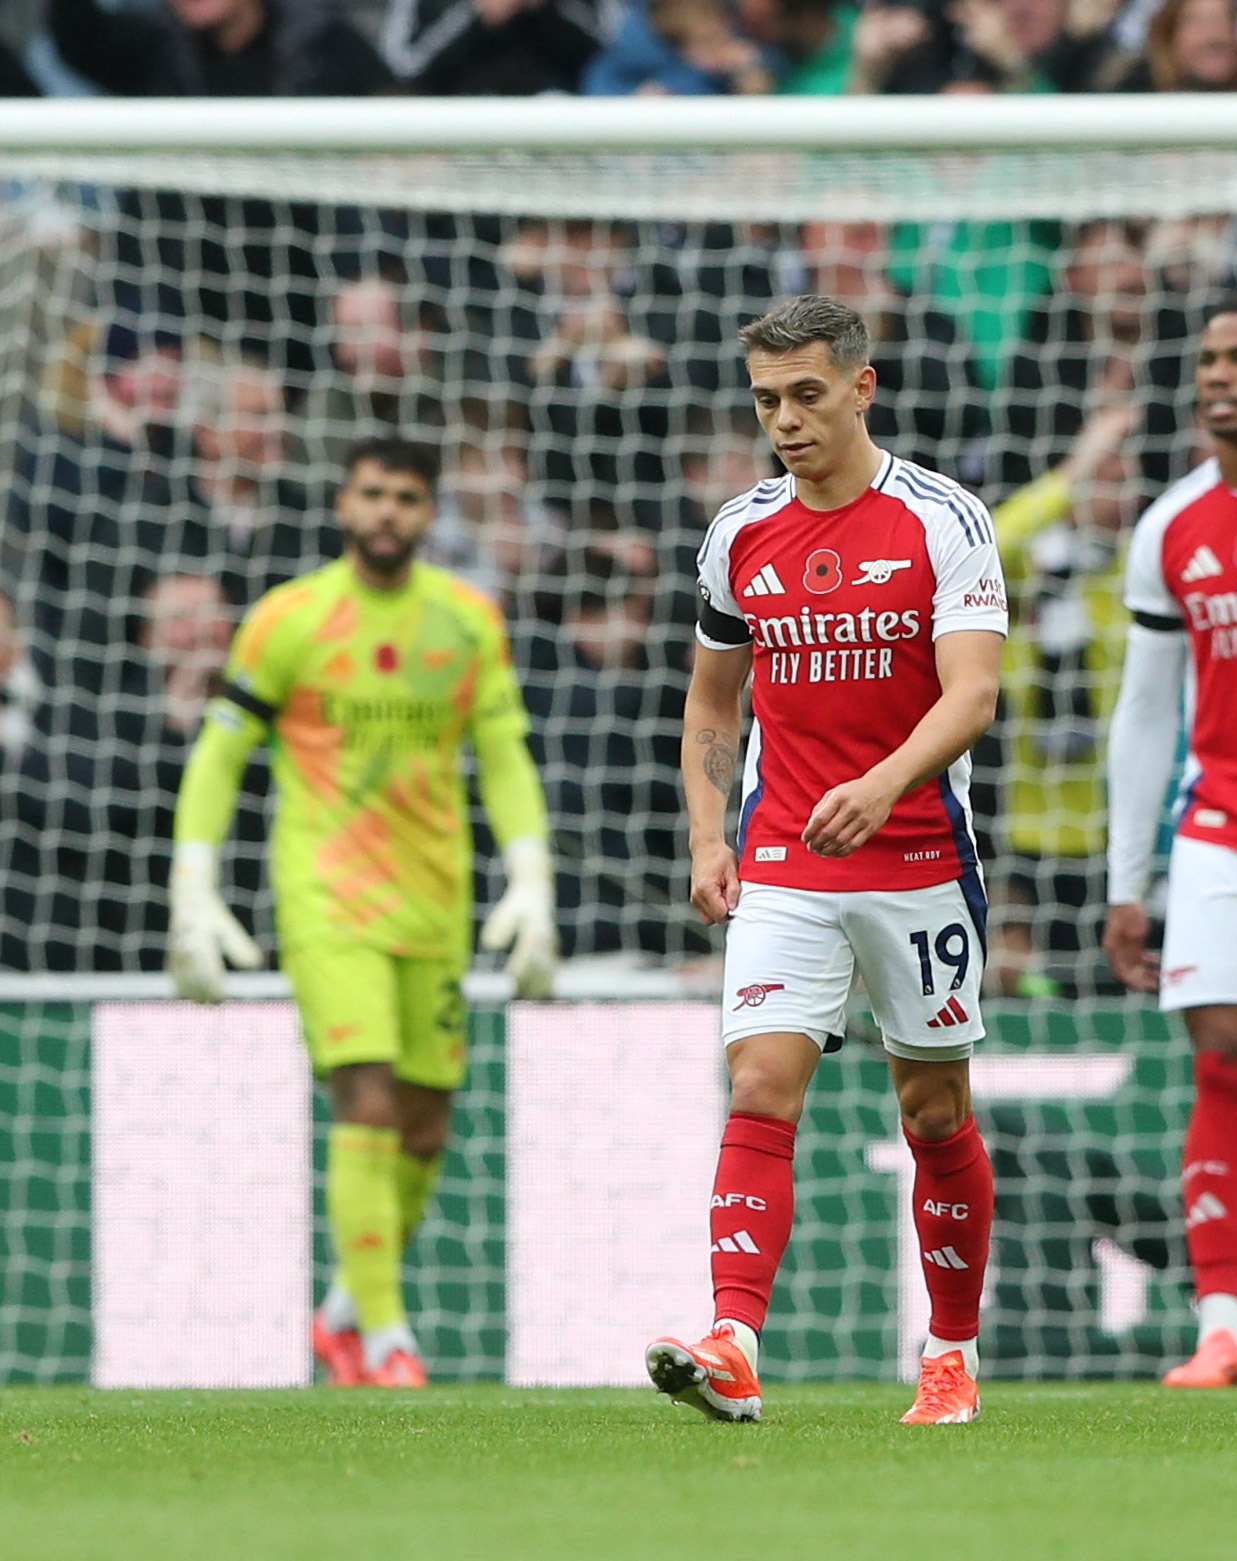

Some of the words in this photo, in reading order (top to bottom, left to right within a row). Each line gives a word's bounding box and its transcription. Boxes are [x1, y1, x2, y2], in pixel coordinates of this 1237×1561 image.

[770, 652, 800, 684] FLY
[809, 648, 892, 682] BETTER
[909, 923, 970, 996] 19
[710, 1193, 767, 1211] AFC
[923, 1198, 968, 1220] AFC
